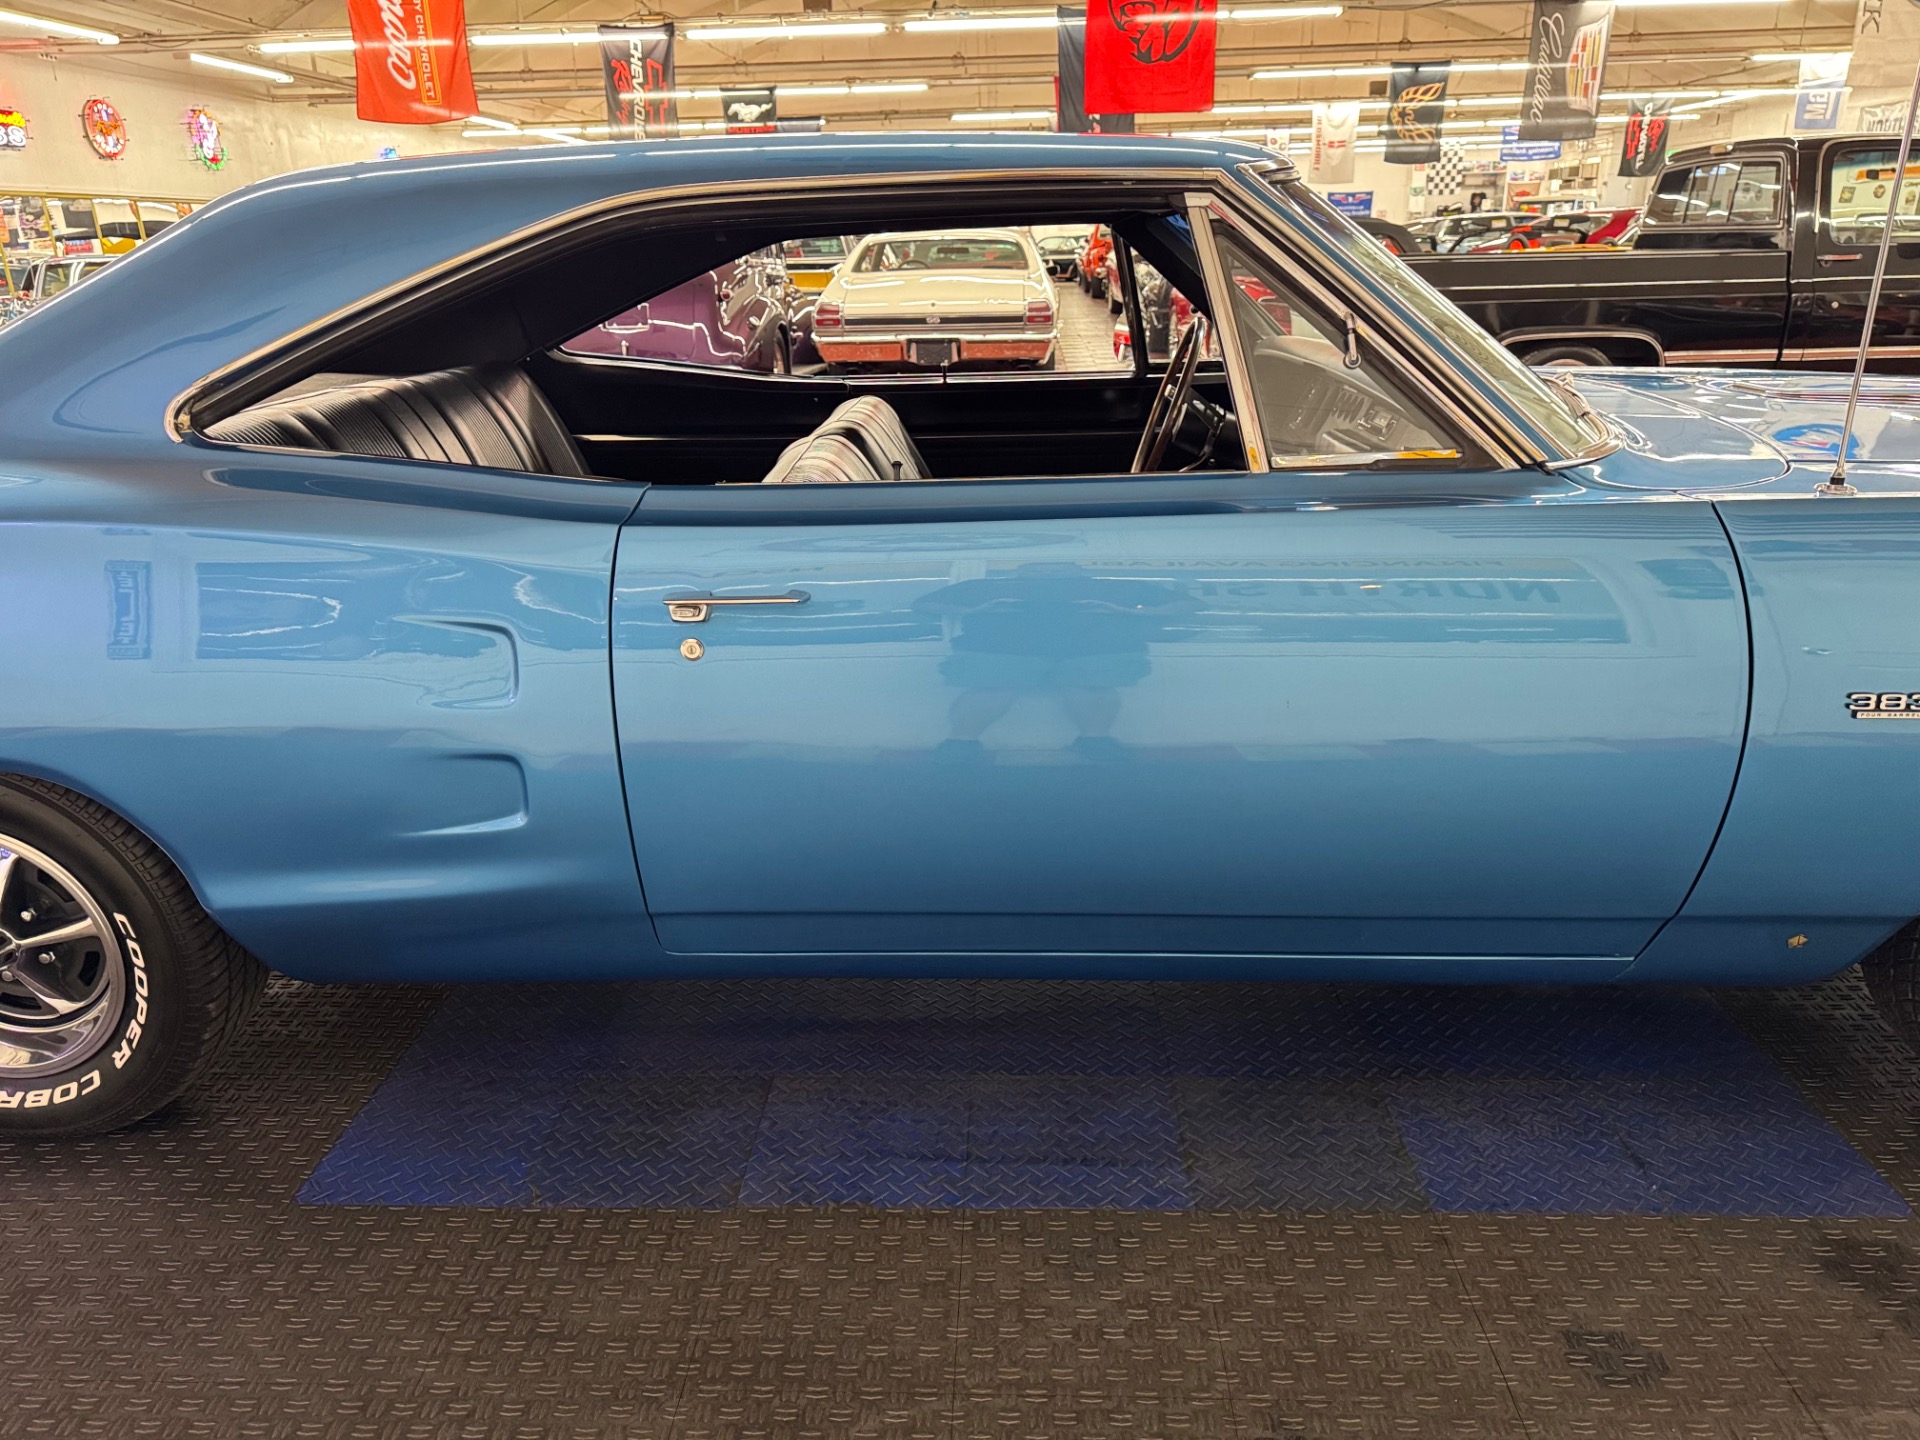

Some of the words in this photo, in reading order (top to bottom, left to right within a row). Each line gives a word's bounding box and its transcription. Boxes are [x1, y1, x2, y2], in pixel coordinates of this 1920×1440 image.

[415, 15, 435, 98] CHEVROLET
[1530, 12, 1564, 124] Cadillac
[112, 912, 148, 1069] COOPER
